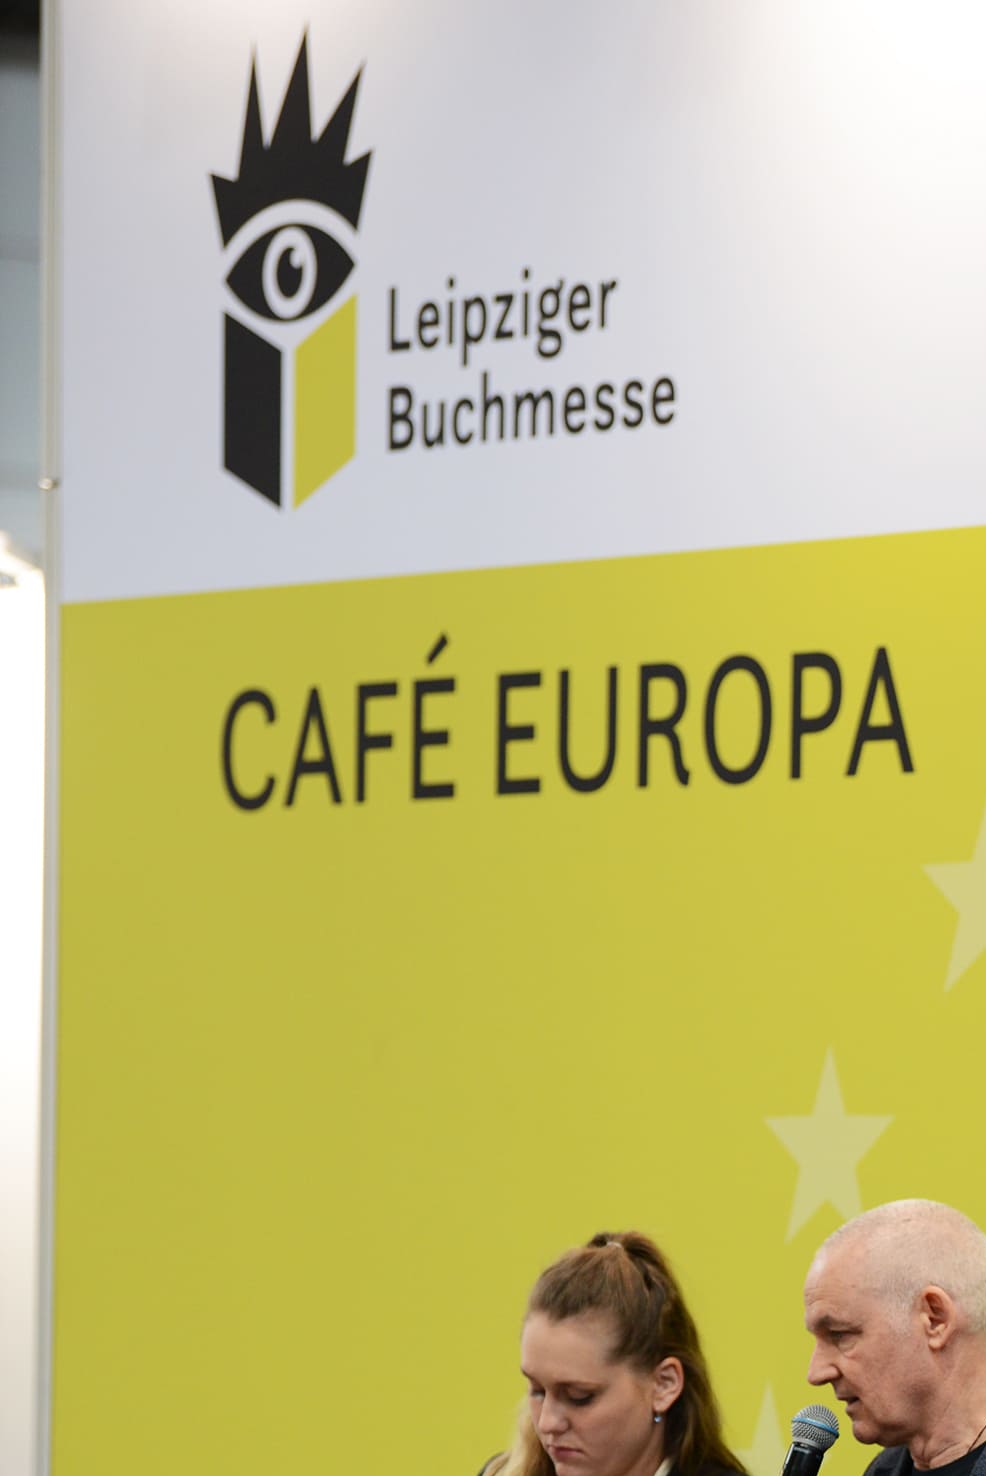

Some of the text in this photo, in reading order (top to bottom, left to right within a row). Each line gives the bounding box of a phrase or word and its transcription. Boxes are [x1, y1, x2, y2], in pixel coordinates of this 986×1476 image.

[388, 268, 619, 367] Leipziger
[387, 370, 677, 452] Buchmesse
[221, 632, 915, 812] CAFÉ EUROPA
